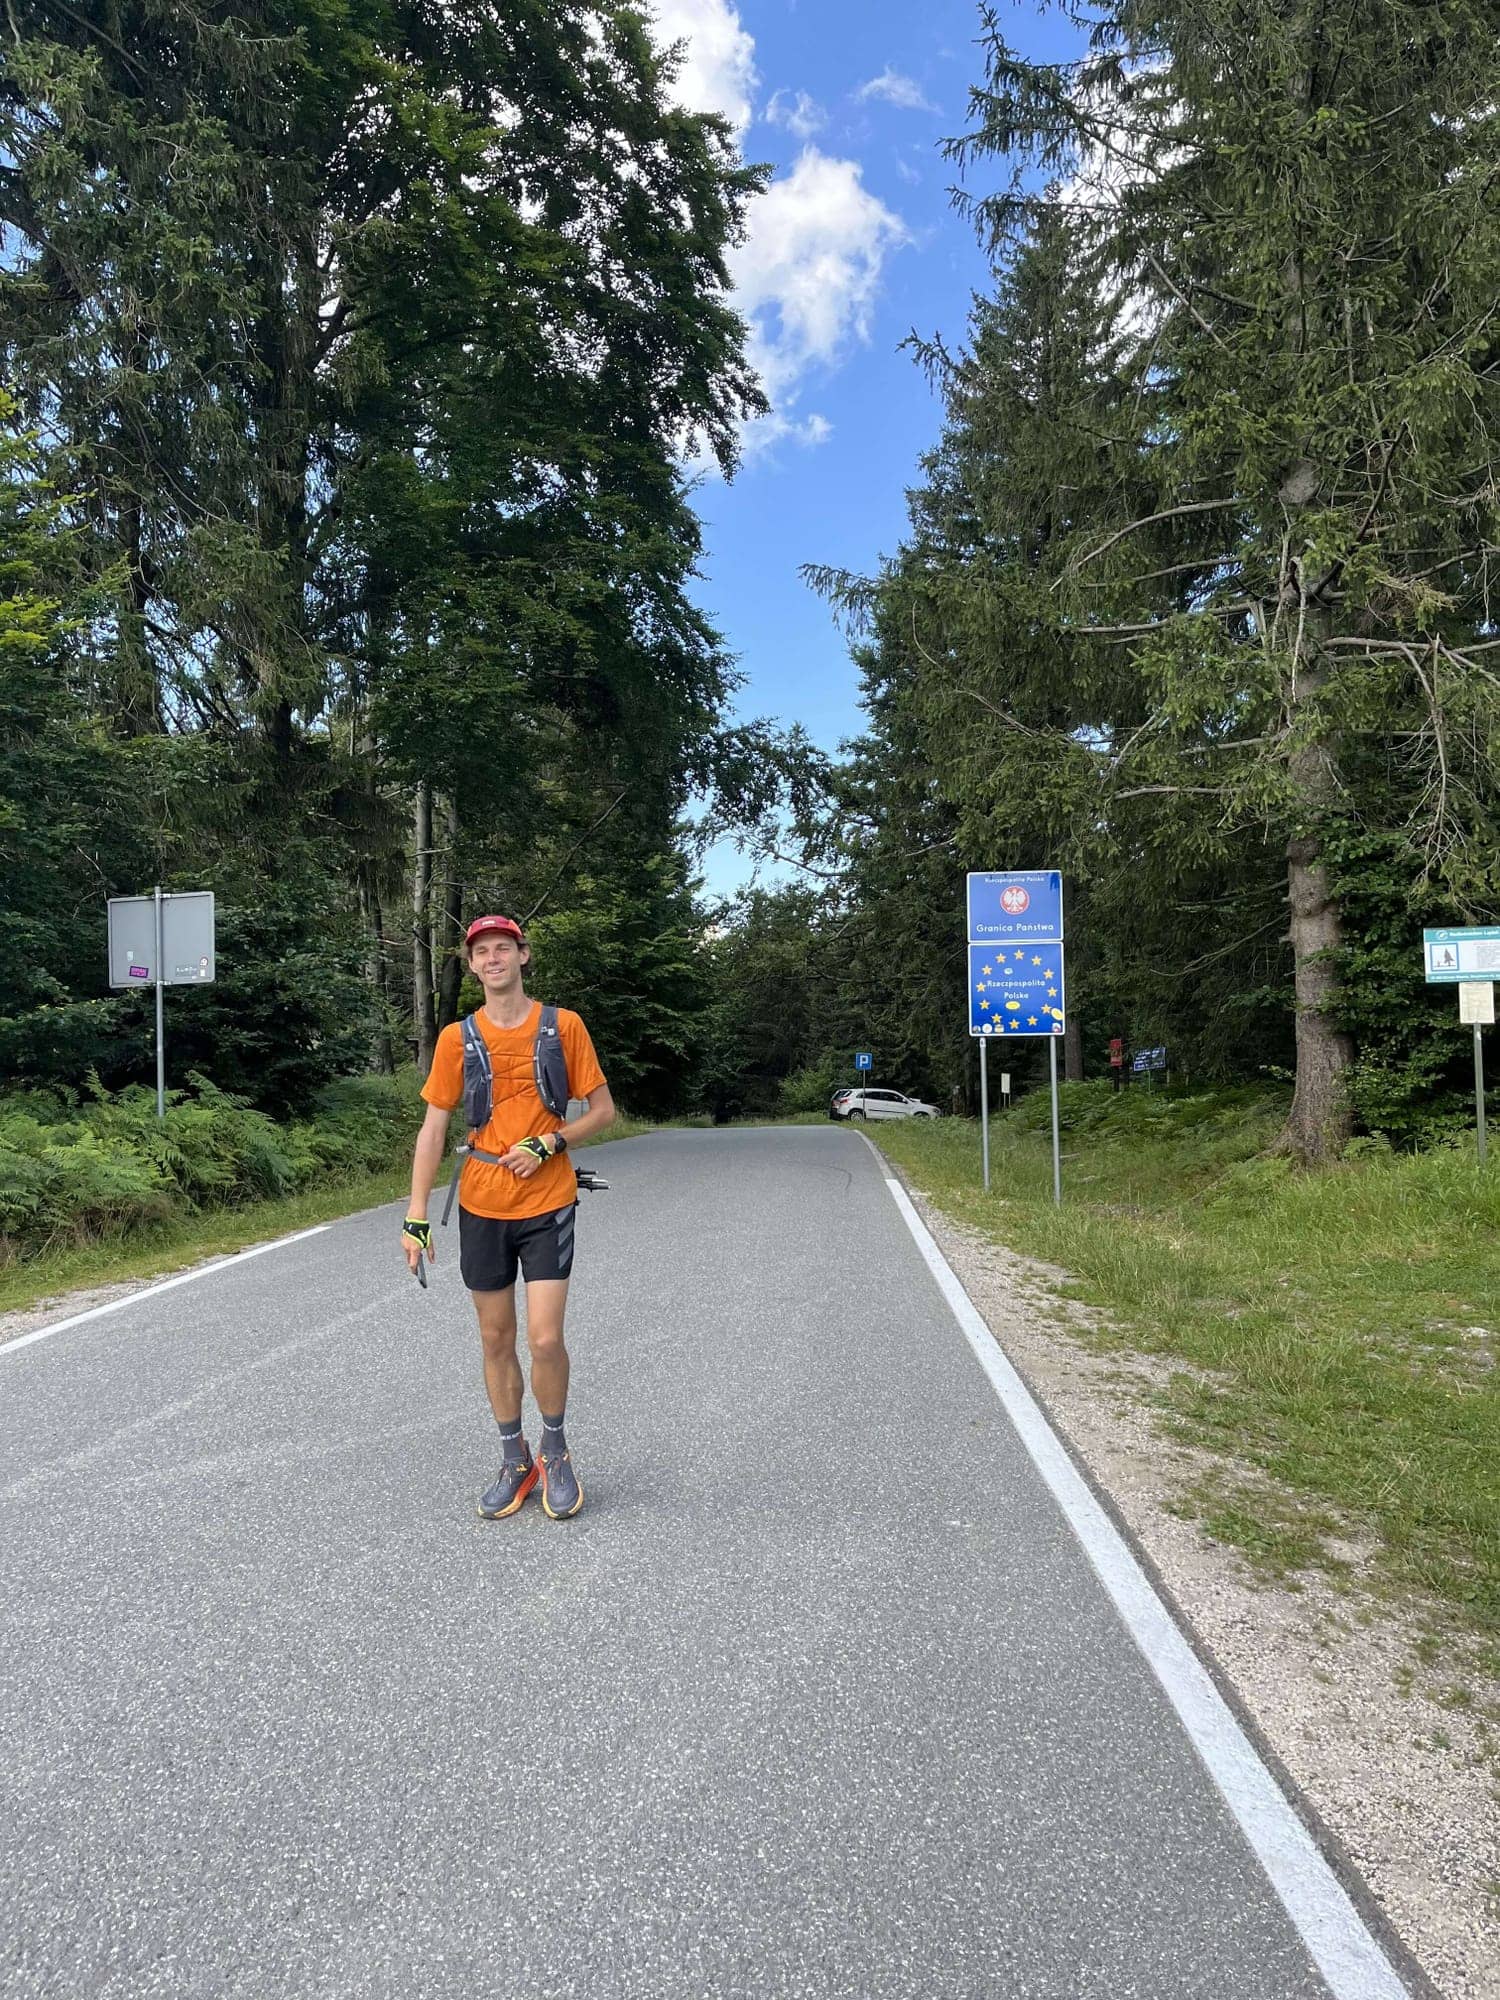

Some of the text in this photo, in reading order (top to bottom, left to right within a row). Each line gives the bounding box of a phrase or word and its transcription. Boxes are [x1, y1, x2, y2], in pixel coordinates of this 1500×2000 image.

[976, 923, 1013, 933] Granica
[986, 979, 1046, 988] Rzeczpospolita
[1003, 991, 1029, 999] Polska
[859, 1055, 869, 1066] P
